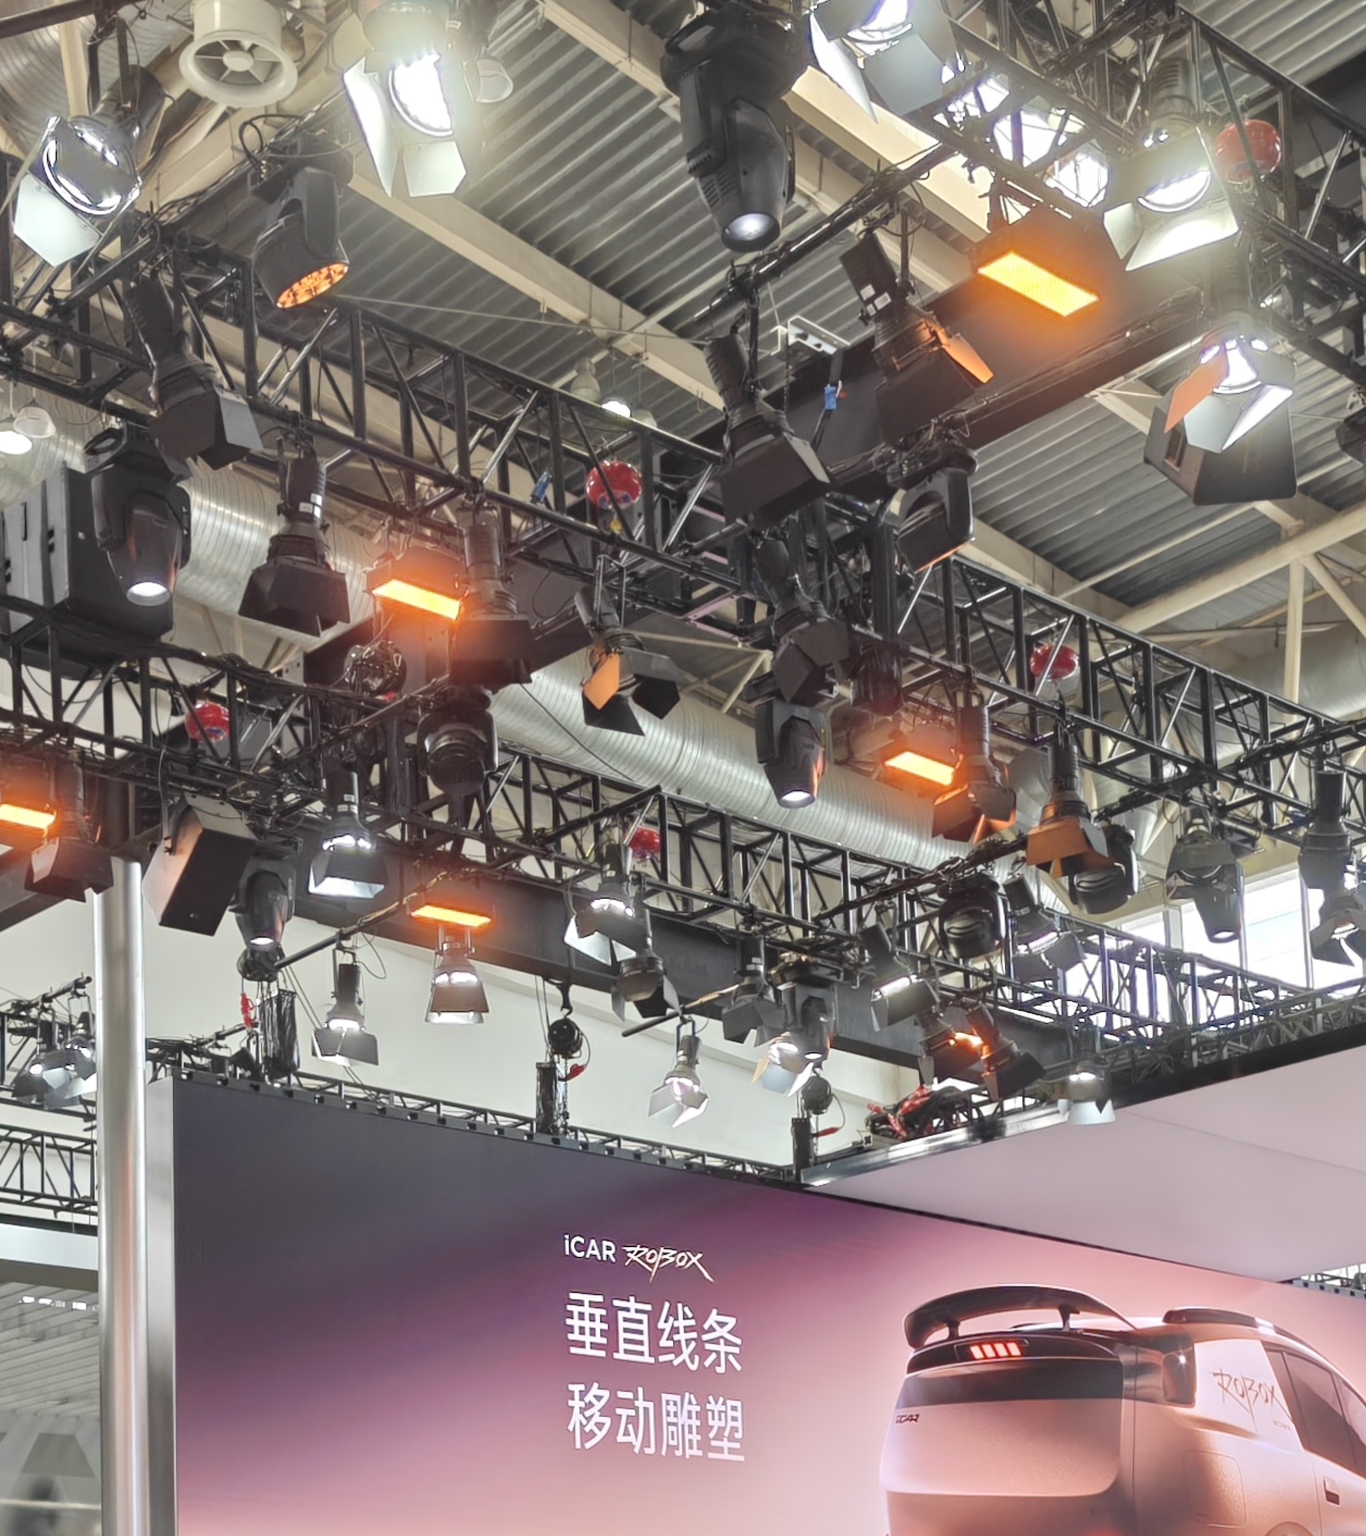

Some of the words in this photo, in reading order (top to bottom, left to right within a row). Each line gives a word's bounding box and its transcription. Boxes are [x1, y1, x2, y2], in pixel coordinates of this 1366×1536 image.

[564, 1234, 616, 1263] iCAR
[565, 1291, 743, 1375] 垂直线条
[567, 1381, 745, 1462] 移动雕塑
